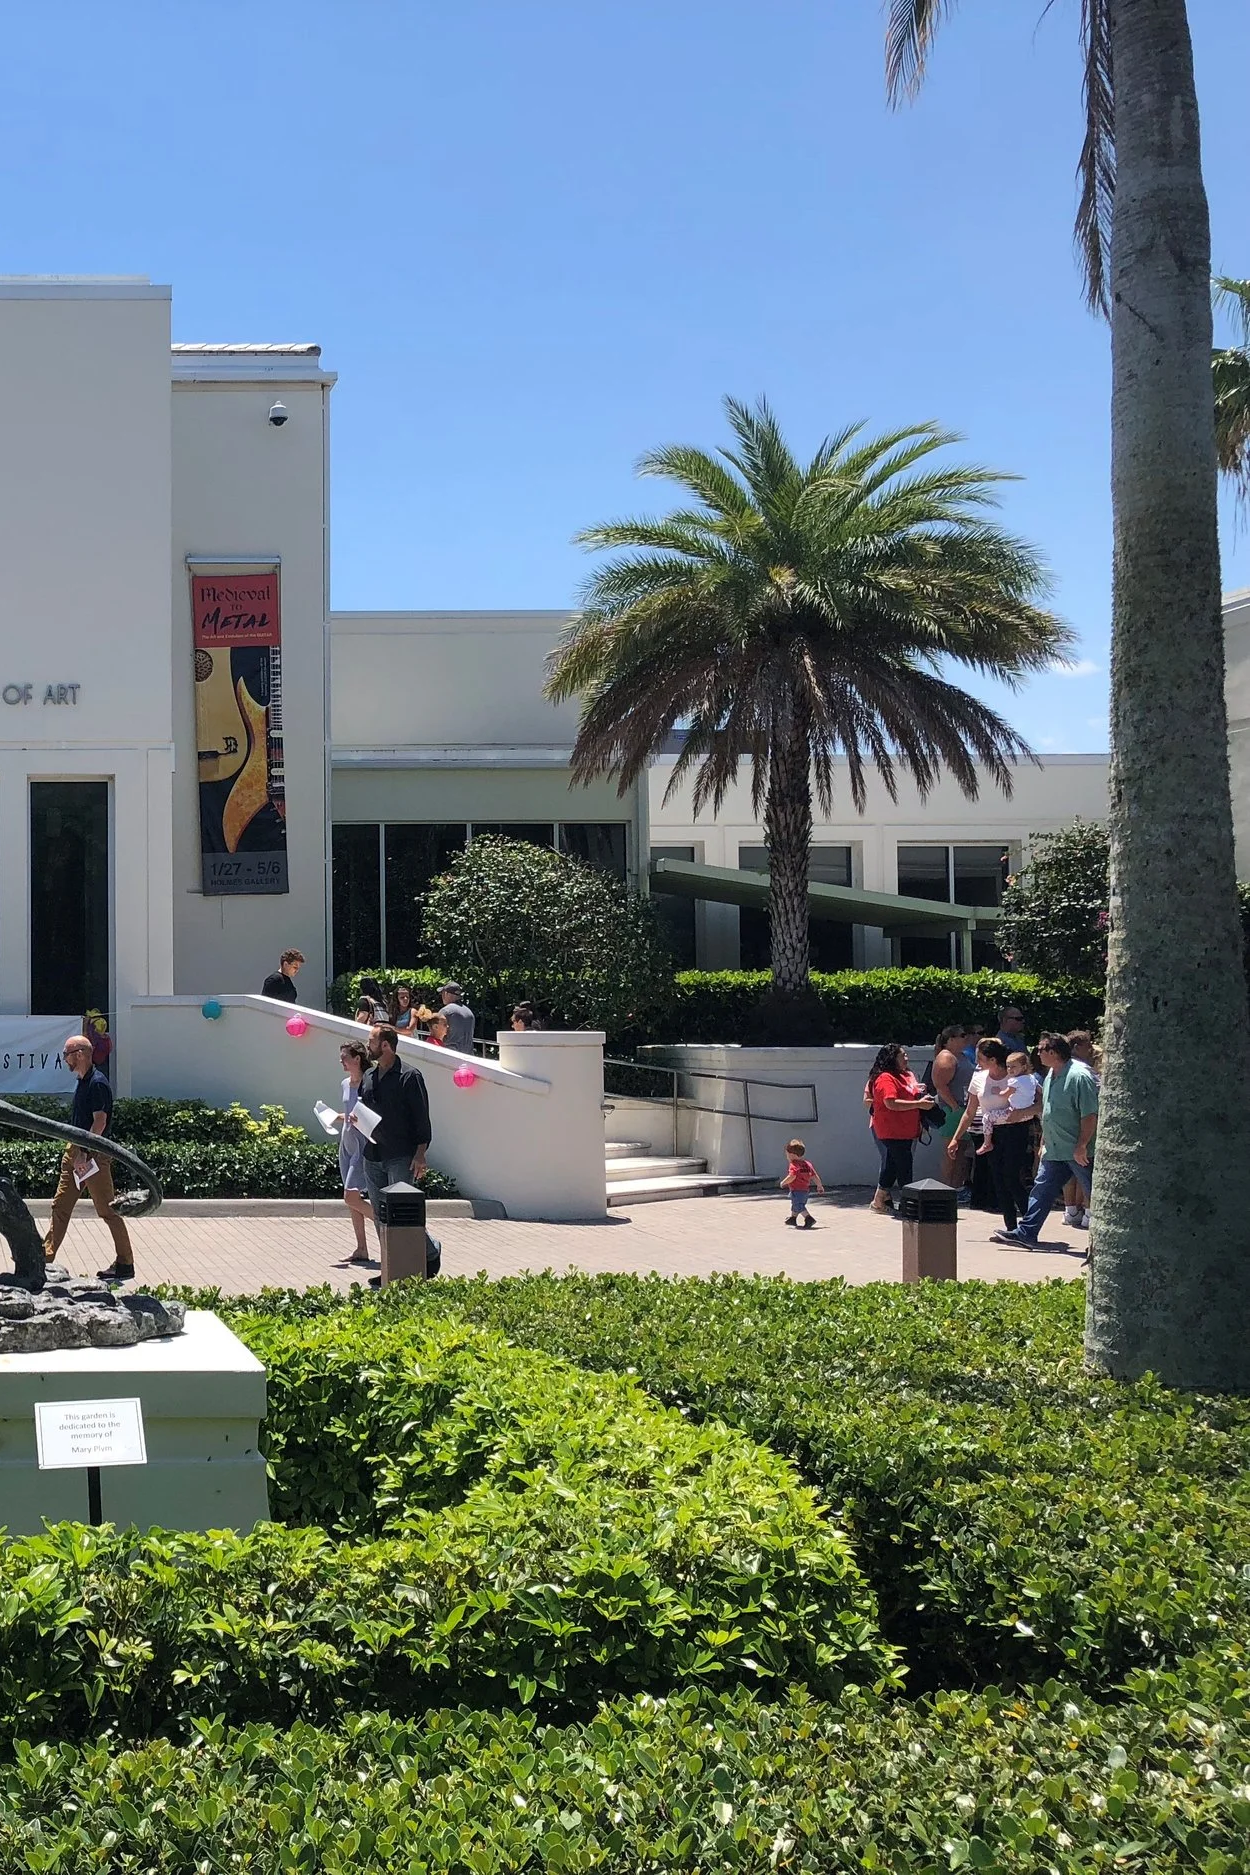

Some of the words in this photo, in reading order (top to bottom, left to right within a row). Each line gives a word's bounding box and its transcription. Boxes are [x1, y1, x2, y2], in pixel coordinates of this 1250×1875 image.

[201, 586, 270, 602] Medieval
[201, 607, 270, 634] METAL
[2, 684, 33, 706] OF
[43, 684, 81, 706] ART
[211, 862, 242, 876] 1/27
[257, 860, 282, 875] 5/6
[211, 878, 242, 886] HOLMES
[244, 877, 280, 885] GALLERY
[81, 1413, 108, 1421] garden
[59, 1422, 96, 1431] dedicated
[71, 1446, 92, 1454] Mary
